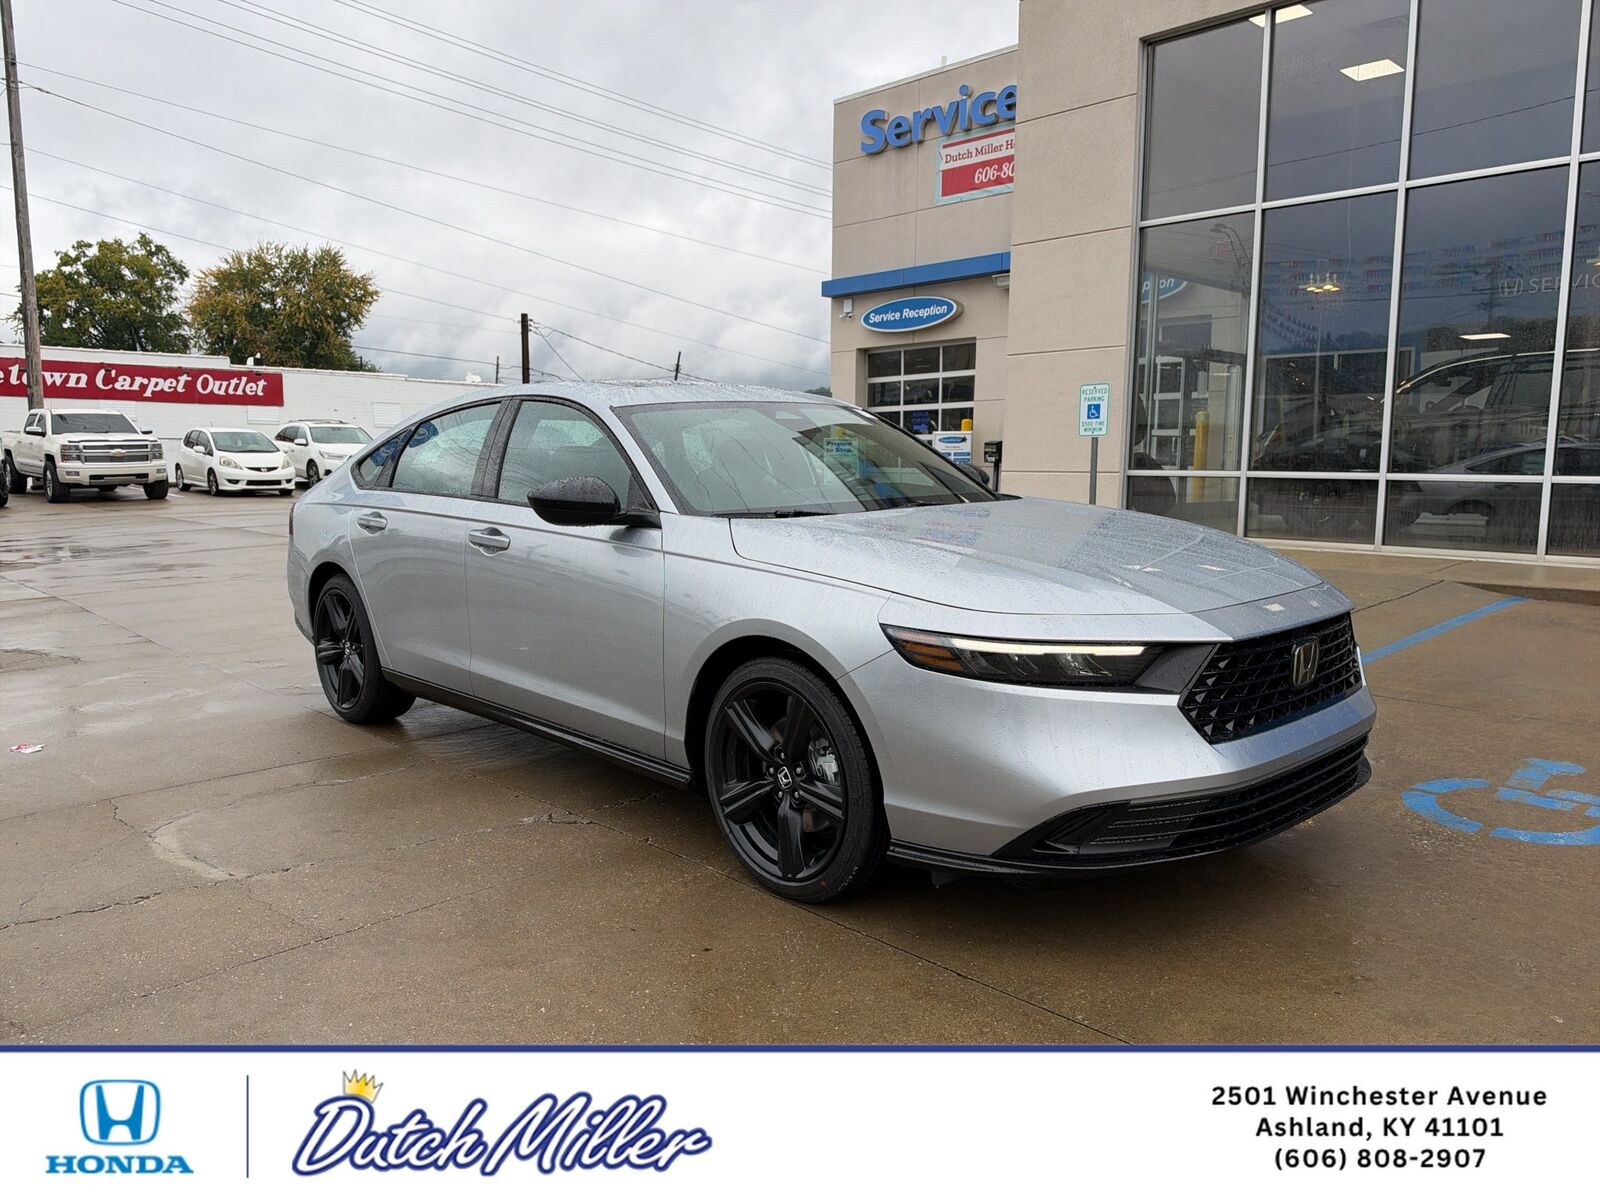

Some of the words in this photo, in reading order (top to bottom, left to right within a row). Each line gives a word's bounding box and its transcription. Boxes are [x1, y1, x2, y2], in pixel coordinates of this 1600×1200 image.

[860, 84, 1018, 155] Service
[944, 149, 973, 164] Dutch
[975, 143, 1004, 157] Miller
[1005, 139, 1015, 150] H
[974, 162, 1015, 184] 606-80
[868, 311, 901, 324] Service
[902, 304, 948, 319] Reception
[95, 368, 192, 398] Carpet
[196, 374, 267, 396] Outlet
[1082, 387, 1108, 395] RESERVED
